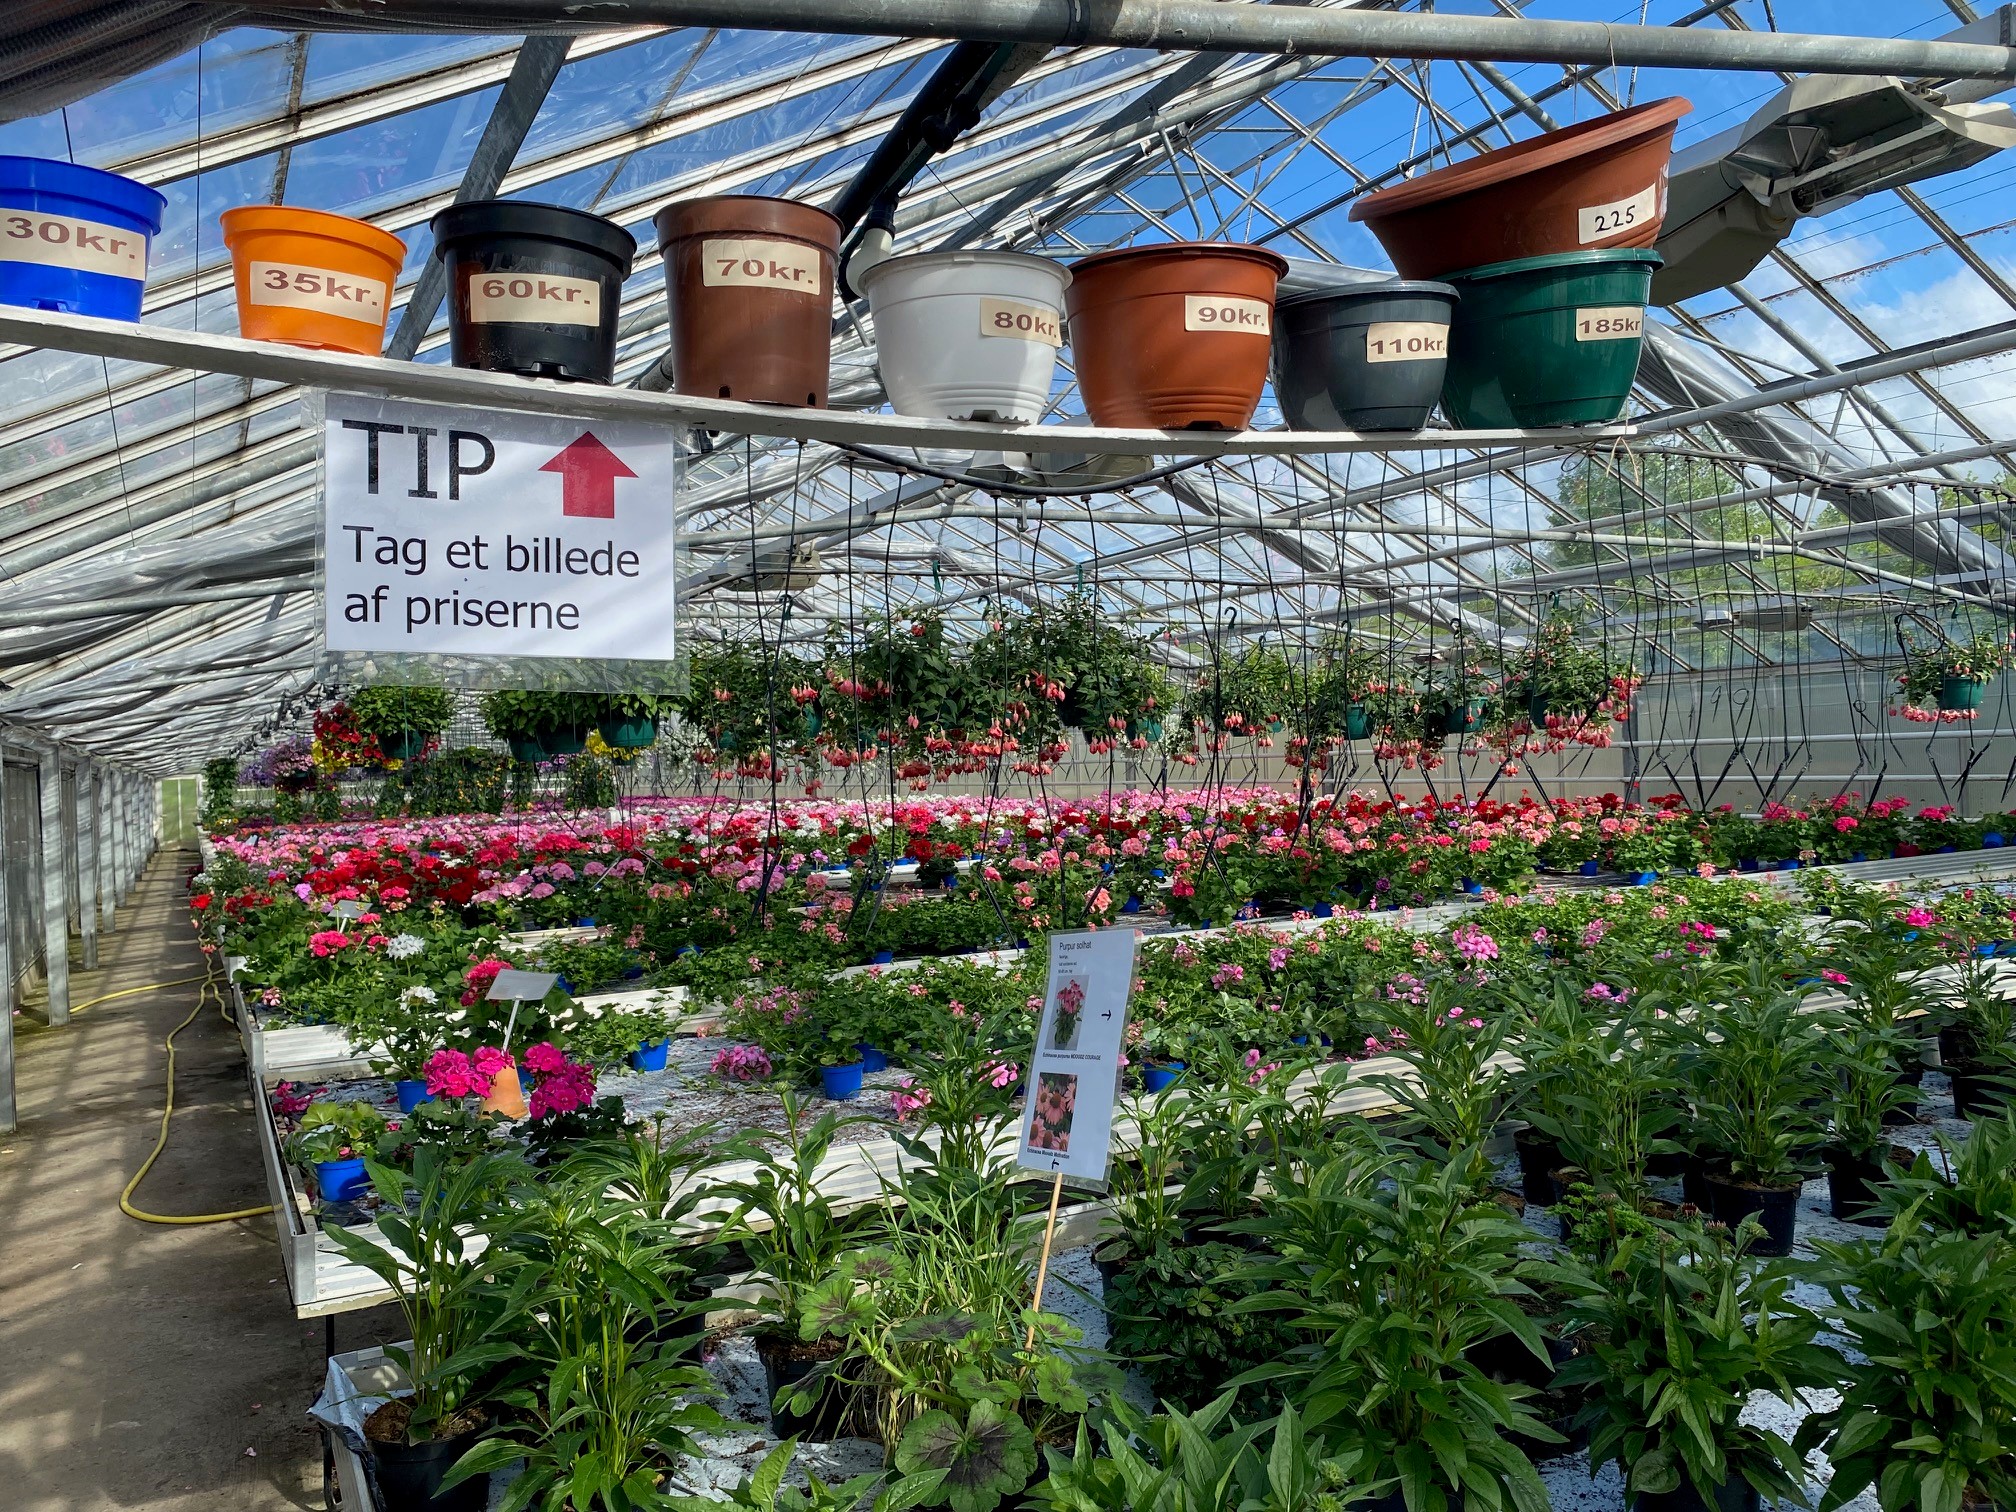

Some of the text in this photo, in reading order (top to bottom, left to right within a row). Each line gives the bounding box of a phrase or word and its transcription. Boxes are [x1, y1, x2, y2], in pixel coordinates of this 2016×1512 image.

[1594, 205, 1636, 233] 225
[6, 217, 135, 259] 30kr.
[264, 269, 378, 306] 35kr.
[717, 259, 813, 284] 70kr.
[482, 279, 591, 305] 60kr.
[994, 312, 1057, 338] 80kr.
[1198, 307, 1265, 327] 90kr.
[342, 419, 496, 501] TIP
[342, 525, 640, 577] Tag et billede
[344, 585, 580, 634] af priserne
